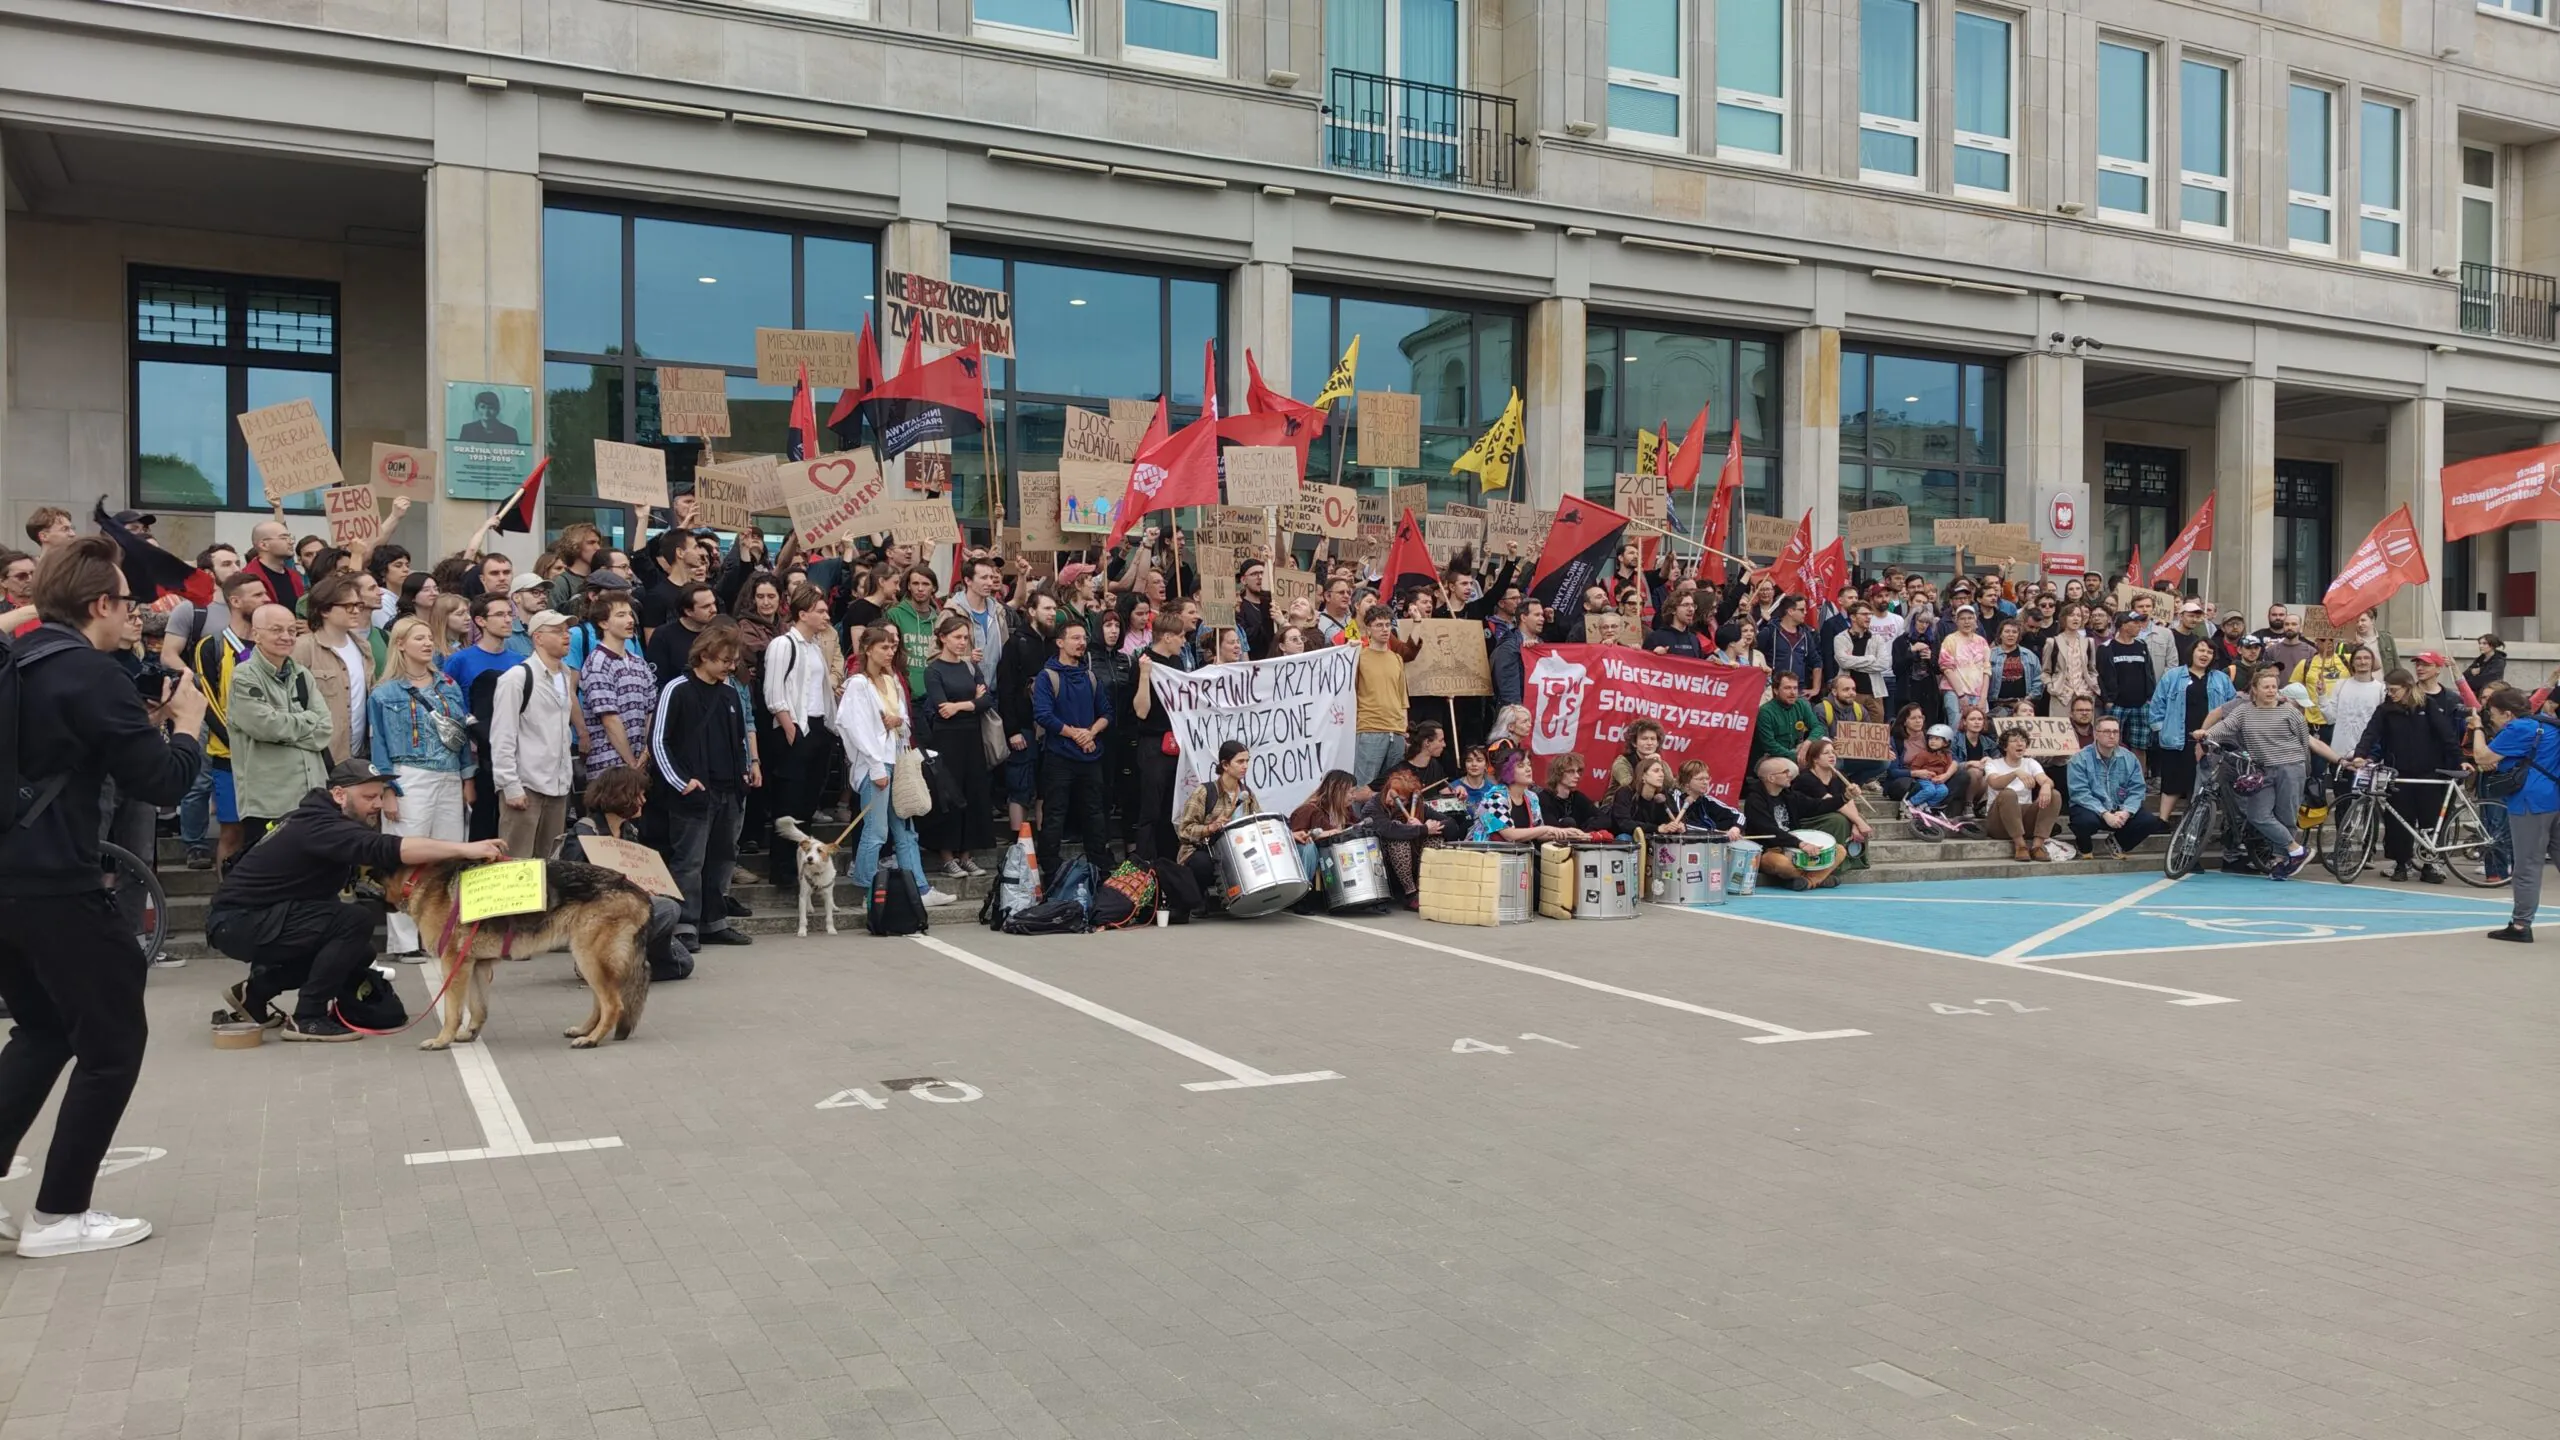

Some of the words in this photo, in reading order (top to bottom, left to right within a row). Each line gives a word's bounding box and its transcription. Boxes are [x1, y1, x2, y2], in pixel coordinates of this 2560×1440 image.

[886, 270, 907, 301] NIE
[947, 284, 1009, 320] KREDYTU
[767, 334, 827, 351] MIESZKANIA
[834, 337, 851, 353] DLA
[819, 354, 832, 367] NIE
[836, 354, 851, 368] DLA
[1068, 428, 1120, 463] GADANIA
[1231, 452, 1294, 470] MIESZKANIE
[699, 476, 748, 505] MIESZKANIA
[1272, 473, 1290, 488] NIE
[1620, 474, 1665, 496] ŻYCIE
[327, 487, 372, 514] ZERO
[1496, 502, 1516, 516] NIE
[1628, 498, 1655, 517] NIE
[699, 502, 715, 524] DLA
[914, 505, 951, 524] KREDYT
[1324, 497, 1355, 527] 0%
[1494, 514, 1520, 529] UFAJ
[332, 514, 379, 543] ZGODY
[1197, 530, 1214, 545] NIE
[1157, 665, 1261, 712] NAPRAWIĆ
[1273, 650, 1357, 701] KRZYWDY
[1602, 658, 1730, 697] Warszawskie
[1599, 689, 1749, 731] Stowarzyszenie
[1839, 723, 1857, 739] NIE
[1928, 998, 2051, 1016] 42
[1450, 1032, 1581, 1055] 41
[814, 1081, 985, 1111] 40
